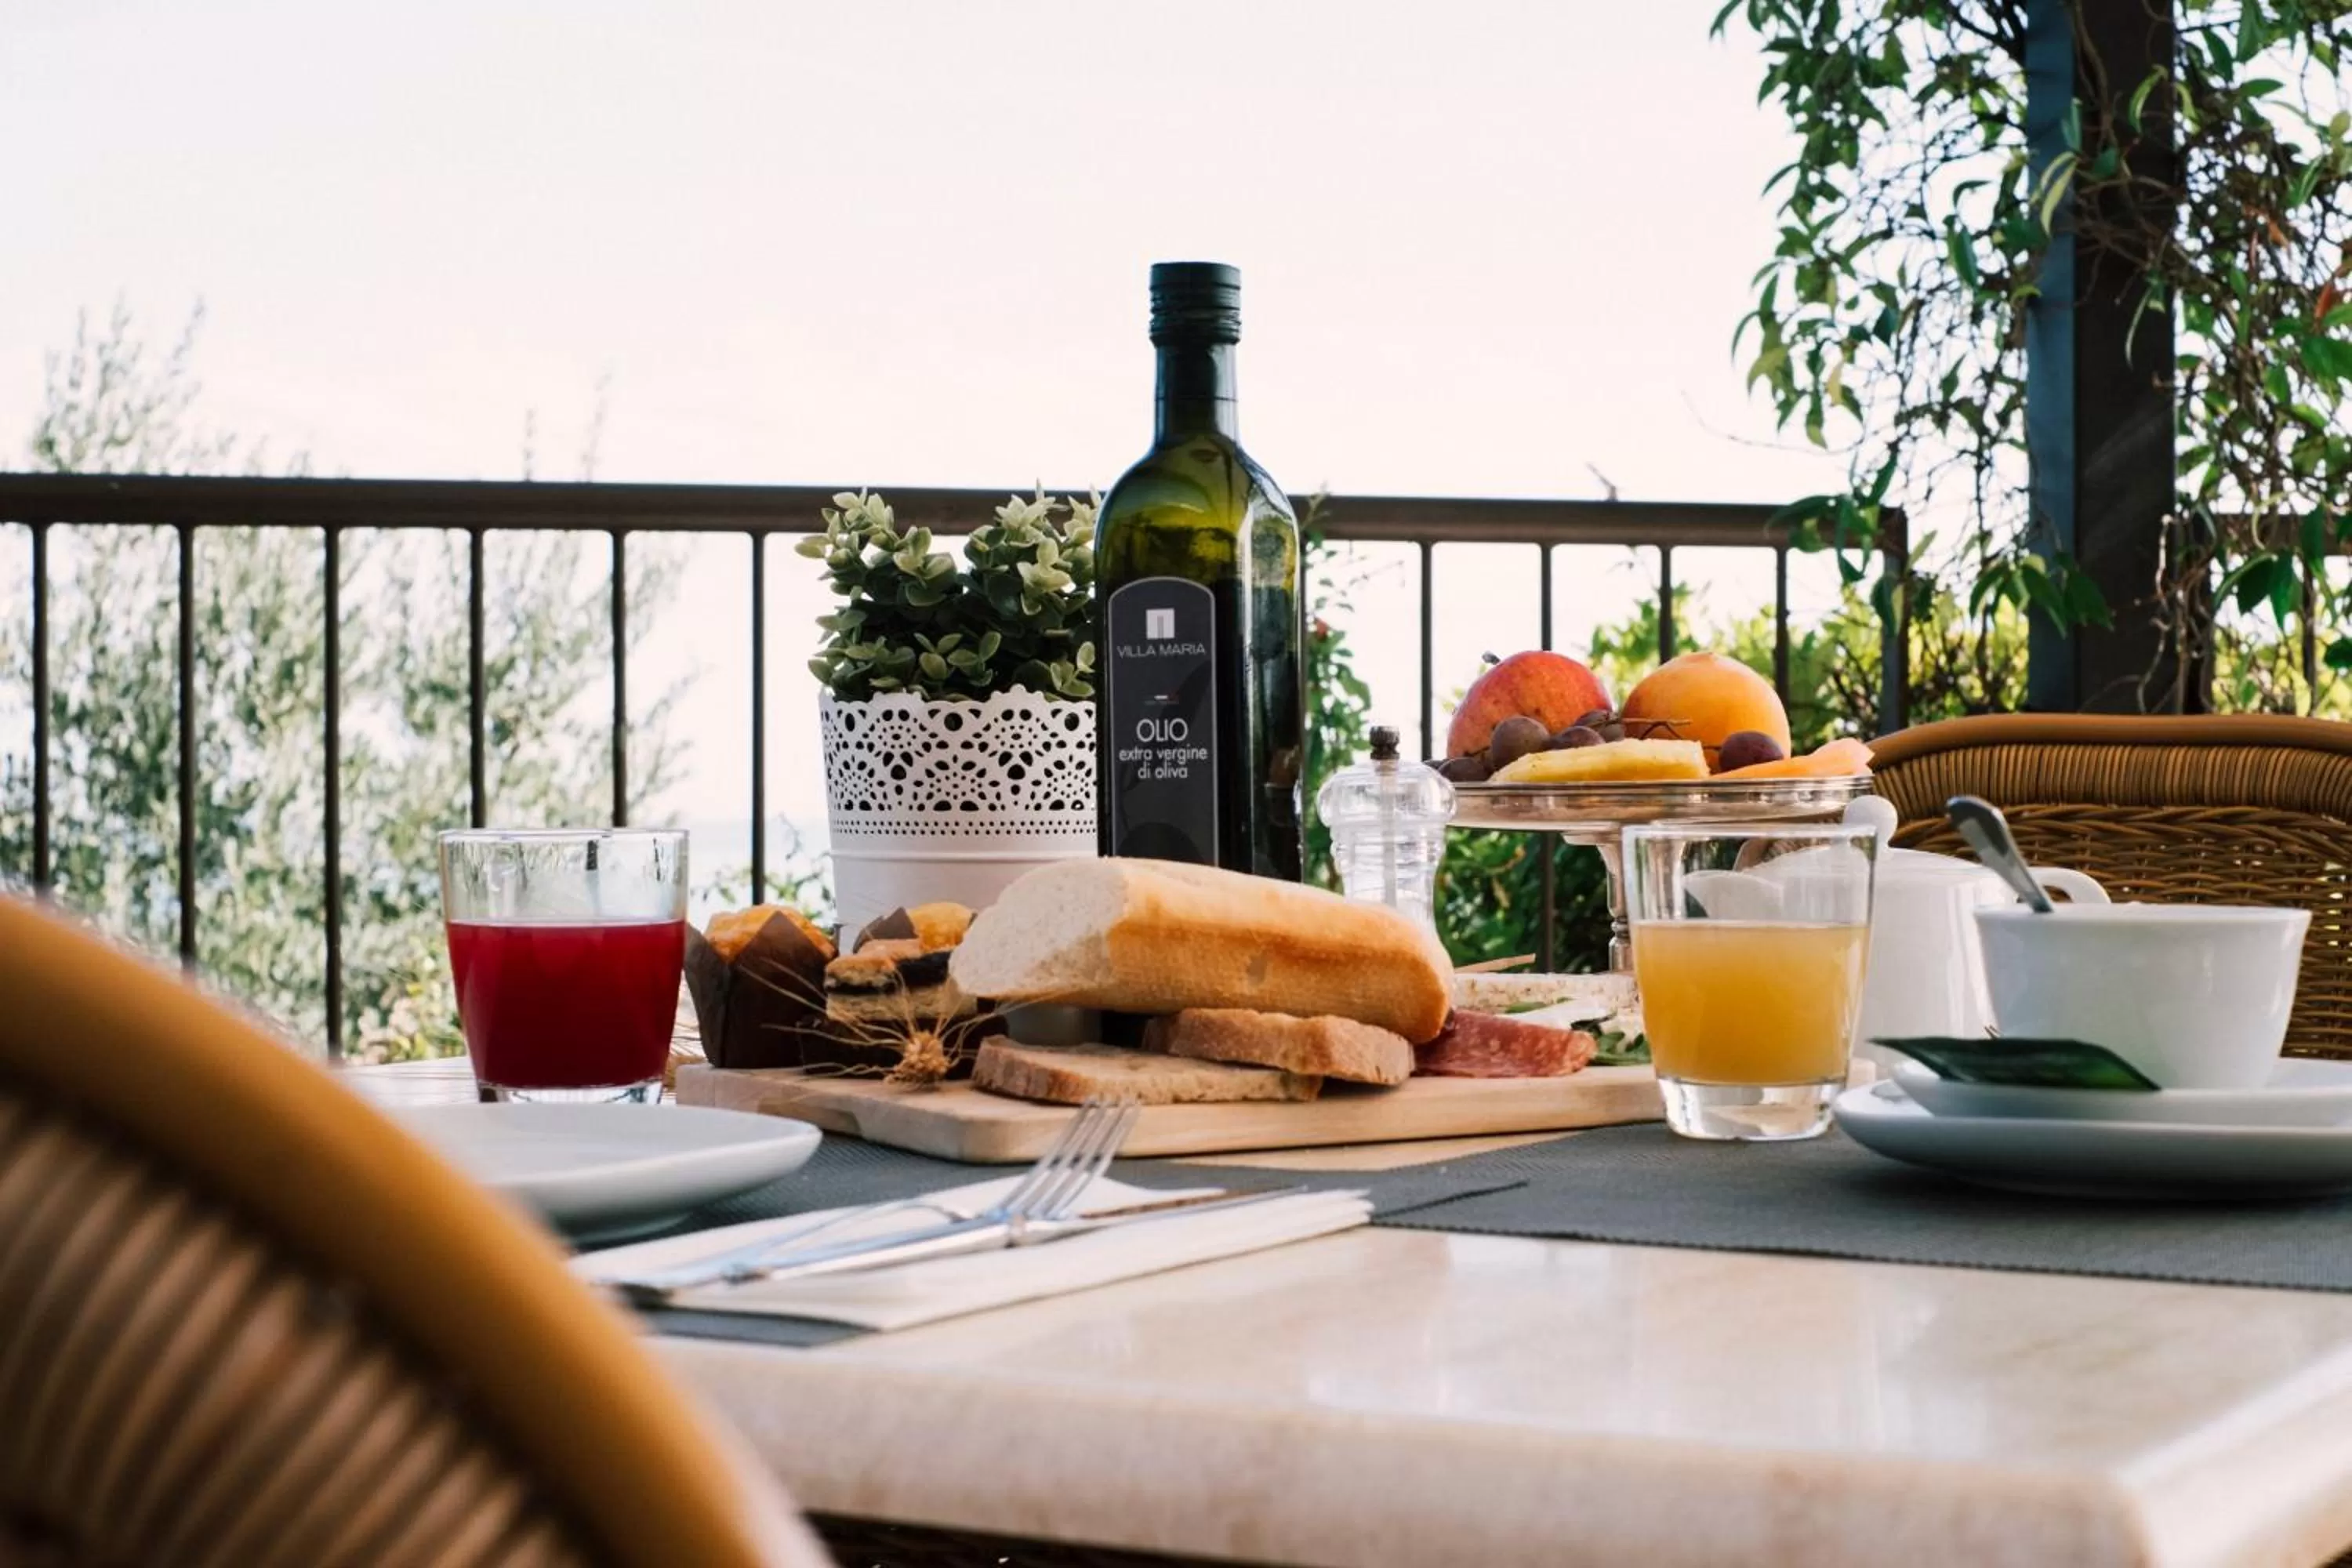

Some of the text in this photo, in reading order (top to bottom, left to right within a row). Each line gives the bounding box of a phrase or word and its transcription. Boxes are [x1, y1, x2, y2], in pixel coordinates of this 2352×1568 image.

[1116, 643, 1206, 659] VILLA MARIA
[1137, 718, 1189, 742] OLIO
[1119, 744, 1208, 764] extra vergine
[1138, 762, 1188, 779] di oliva
